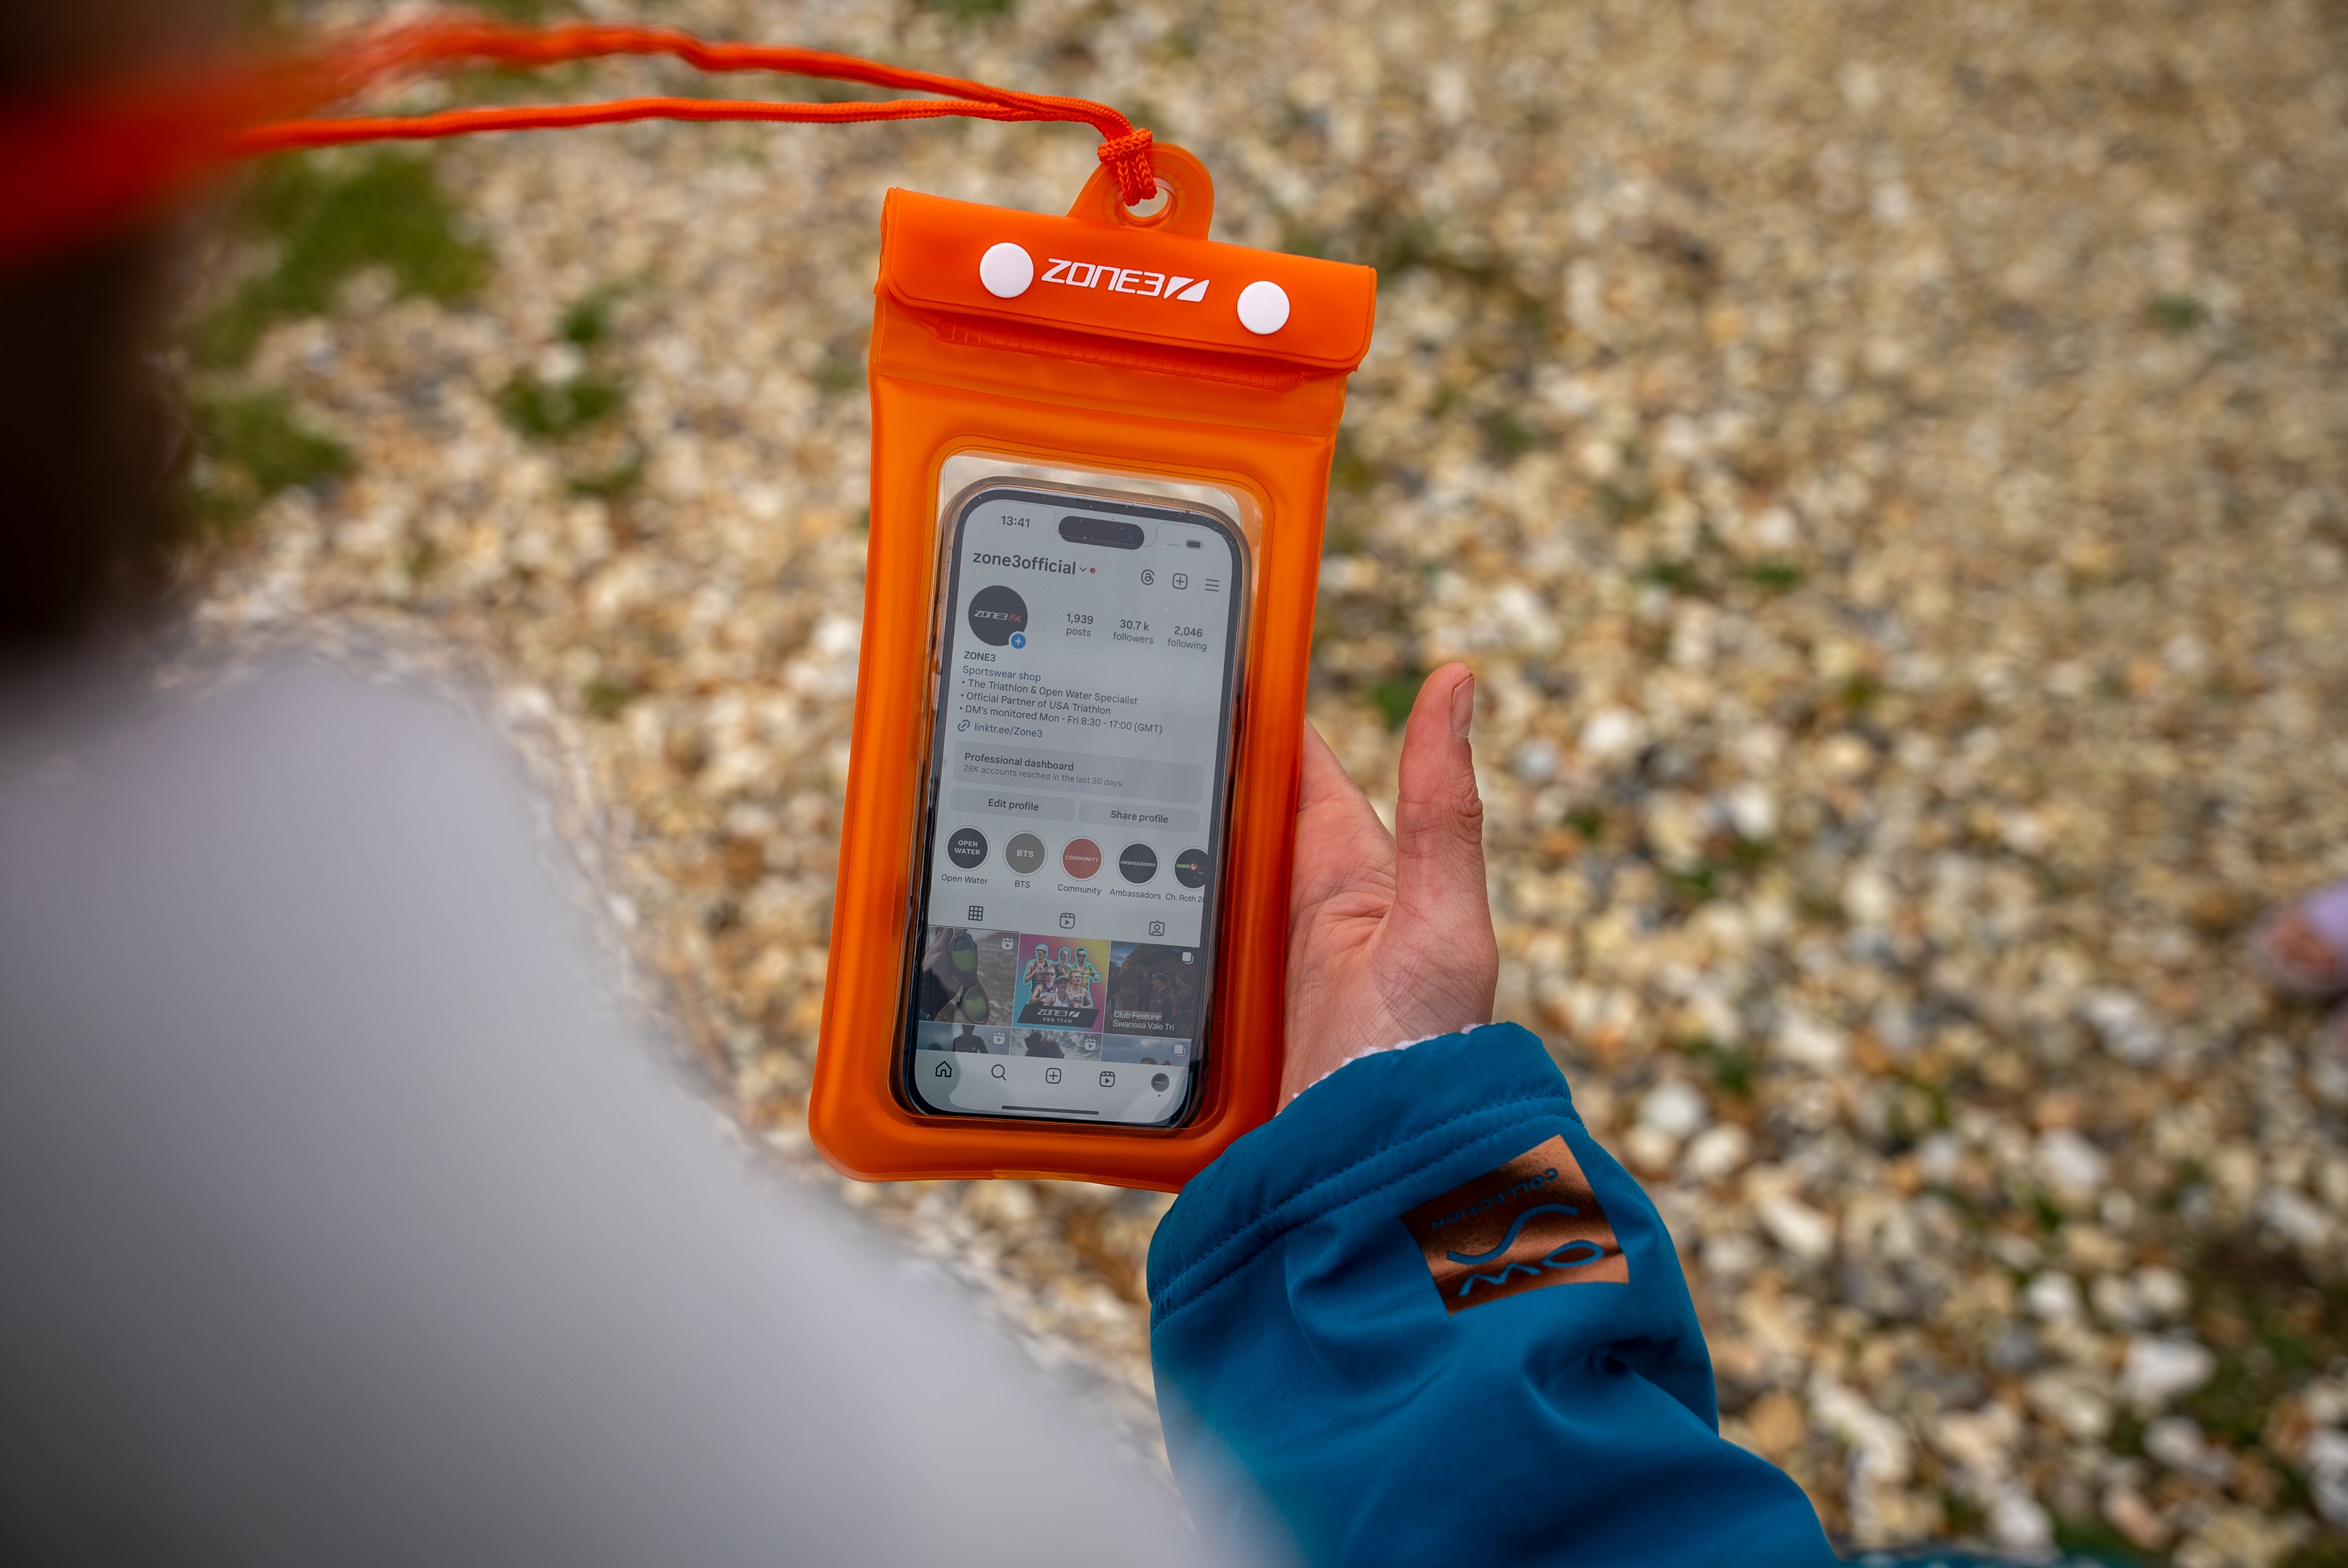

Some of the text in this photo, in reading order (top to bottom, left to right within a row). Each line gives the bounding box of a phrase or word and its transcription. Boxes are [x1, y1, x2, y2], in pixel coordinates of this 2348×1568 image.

[1041, 258, 1165, 297] ZONE3
[1001, 515, 1030, 528] 13:41
[973, 553, 1076, 575] zone3official
[974, 610, 1008, 620] ZONE3
[1066, 613, 1094, 625] 1,939
[1120, 620, 1141, 630] 30.7
[1066, 628, 1091, 637] posts
[1174, 626, 1203, 637] 2,046
[1113, 632, 1154, 644] followers
[1167, 638, 1207, 652] following
[964, 651, 996, 662] ZONE3
[962, 666, 1041, 683] Sportswear shop
[969, 679, 986, 688] The
[989, 681, 1028, 693] Triathlon
[1039, 687, 1063, 697] Open
[1065, 689, 1092, 700] Water
[1094, 693, 1138, 705] Specialist
[966, 692, 998, 703] Official
[1001, 695, 1036, 706] Partner
[1049, 701, 1069, 710] USA
[1072, 703, 1111, 715] Triathlon
[965, 705, 988, 714] DM's
[990, 708, 1037, 720] monitored
[1039, 713, 1059, 723] Mon
[1068, 715, 1079, 724] Fri
[1081, 717, 1101, 727] 8:30
[1109, 720, 1132, 730] 17:00
[1134, 722, 1162, 735] (GMT)
[974, 723, 1043, 737] linktr.ee/Zone3
[965, 752, 1074, 771] Professional dashboard
[964, 765, 979, 773] 28K
[981, 767, 1017, 777] accounts
[1019, 771, 1051, 780] reached
[1076, 776, 1090, 784] last
[1104, 778, 1124, 788] days.
[988, 798, 1039, 811] Edit profile
[1110, 810, 1168, 823] Share profile
[1016, 849, 1034, 858] BTS
[941, 874, 988, 885] Open Water
[1015, 880, 1031, 889] BTS
[1057, 884, 1101, 896] Community
[1109, 888, 1161, 900] Ambassadors
[1179, 894, 1196, 902] Roth
[1037, 1008, 1068, 1017] ZONE3
[1114, 1010, 1162, 1022] Club Feature:
[1113, 1020, 1146, 1029] Swansea
[1147, 1022, 1163, 1030] Vale
[1430, 1168, 1558, 1230] COLLECTION
